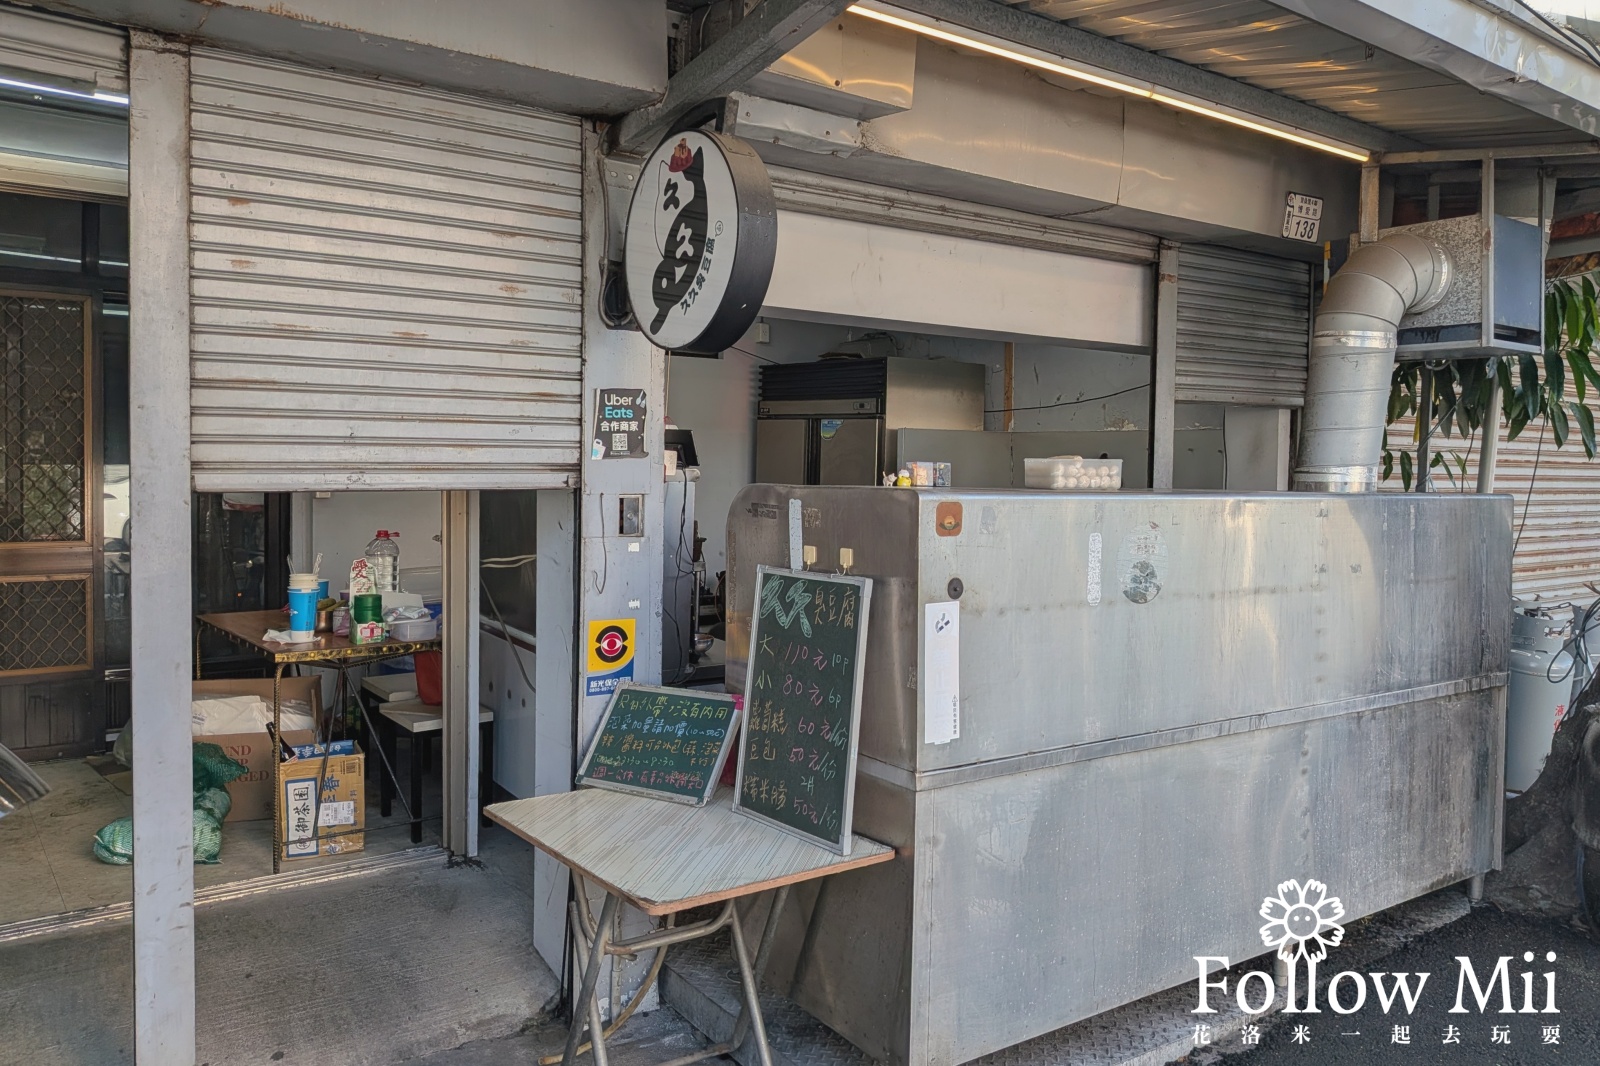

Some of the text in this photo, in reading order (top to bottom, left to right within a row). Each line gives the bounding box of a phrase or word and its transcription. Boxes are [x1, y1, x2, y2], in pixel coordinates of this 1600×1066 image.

[1294, 219, 1316, 239] 138
[604, 394, 633, 406] Uber
[605, 407, 633, 418] Eats
[600, 421, 639, 432] 合作商家
[759, 634, 774, 656] 大
[755, 669, 772, 690] 小
[226, 745, 252, 757] ND
[749, 737, 776, 761] 豆包
[293, 786, 311, 834] 御茶園
